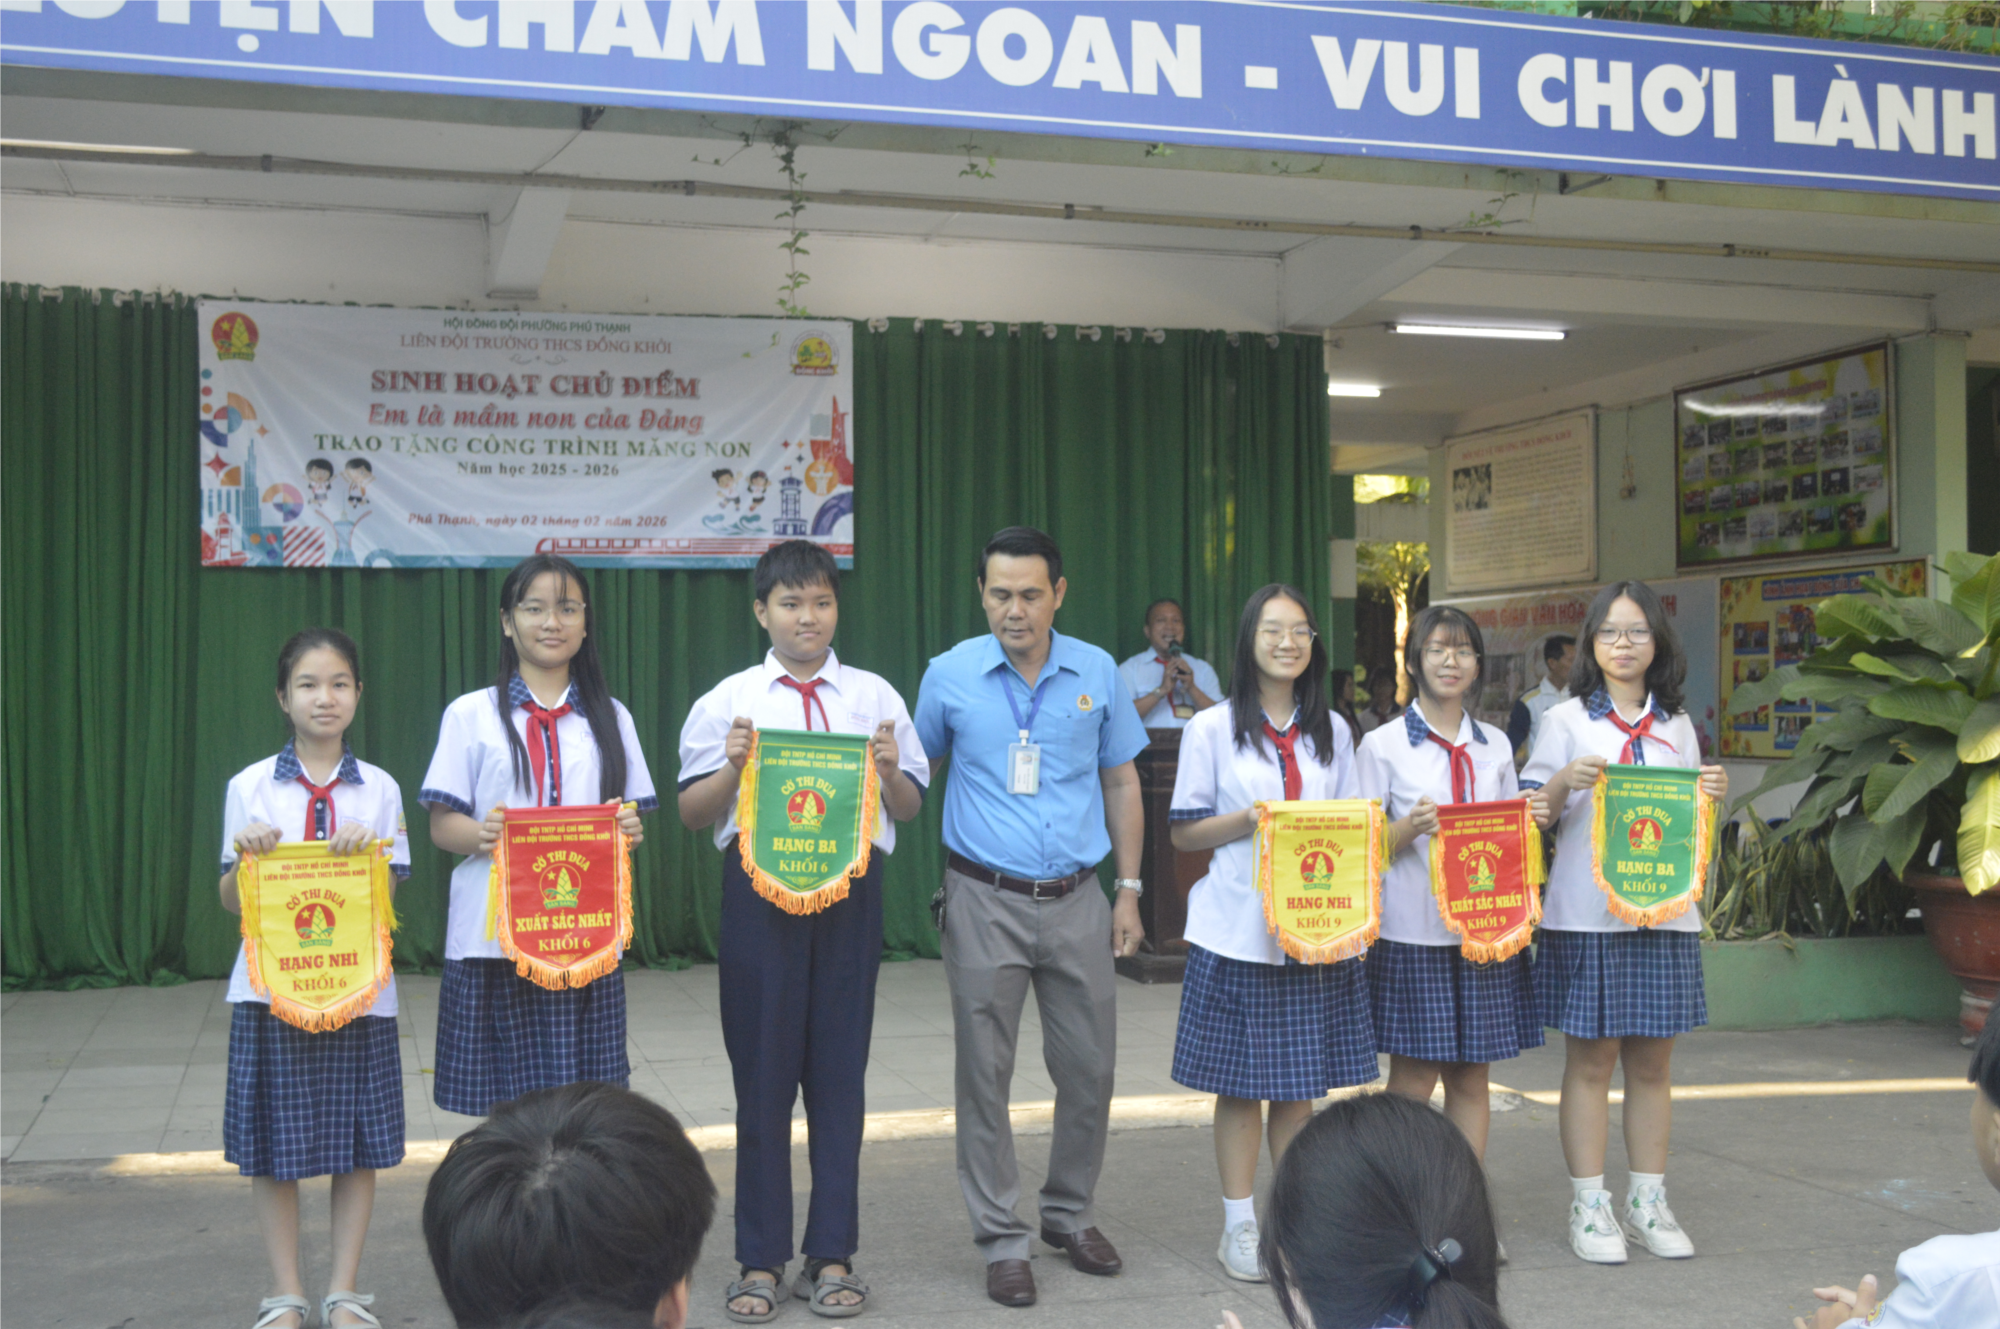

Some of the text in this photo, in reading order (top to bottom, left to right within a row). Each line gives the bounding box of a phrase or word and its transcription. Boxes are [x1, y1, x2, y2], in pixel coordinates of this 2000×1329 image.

[806, 0, 1202, 99] NGOAN
[1244, 65, 1278, 89] -
[1310, 34, 1480, 120] VUI
[1517, 52, 1737, 140] CHƠI
[1772, 64, 1996, 159] LÀNH
[444, 317, 630, 334] HỘI ĐỒNG ĐỘI PHƯỜNG PHÚ THẠNH
[401, 333, 671, 354] LIÊN ĐỘI TRƯỜNG THCS ĐỒNG KHỞI
[370, 369, 701, 400] SINH HOẠT CHỦ ĐIỂM
[368, 402, 704, 436] Em là mầm non của Đảng
[314, 434, 752, 458] TRAO TẶNG CÔNG TRÌNH MĂNG NON
[458, 461, 493, 476] Năm
[498, 461, 526, 478] học
[531, 463, 568, 477] 2025
[584, 464, 620, 478] 2026
[408, 513, 433, 525] Phú
[485, 514, 517, 528] ngày
[521, 516, 538, 526] 02
[542, 514, 579, 528] tháng
[584, 516, 600, 526] 02
[604, 515, 633, 527] năm
[636, 516, 668, 528] 2026
[781, 776, 836, 799] CỜ THI ĐUA
[1623, 806, 1672, 826] CỜ THI ĐUA
[773, 838, 837, 854] HẠNG BA
[1294, 838, 1343, 857] CỜ THI ĐUA
[1458, 841, 1503, 861] CỜ THI ĐUA
[532, 851, 590, 872] CỜ THI ĐUA
[779, 856, 828, 873] KHỐI 6
[1617, 861, 1675, 876] HẠNG BA
[1623, 877, 1666, 893] KHỐI 9
[286, 889, 345, 910] CỜ THI ĐUA
[1286, 894, 1351, 912] HẠNG NHÌ
[1450, 890, 1522, 914] XUẤT SẮC NHẤT
[515, 908, 612, 932] XUẤT SẮC NHẤT
[1297, 912, 1341, 928] KHỐI 9
[1467, 912, 1506, 930] KHỐI 9
[539, 932, 590, 951] KHỐI 6
[279, 949, 358, 973] HẠNG NHÌ
[293, 972, 346, 992] KHỐI 6
